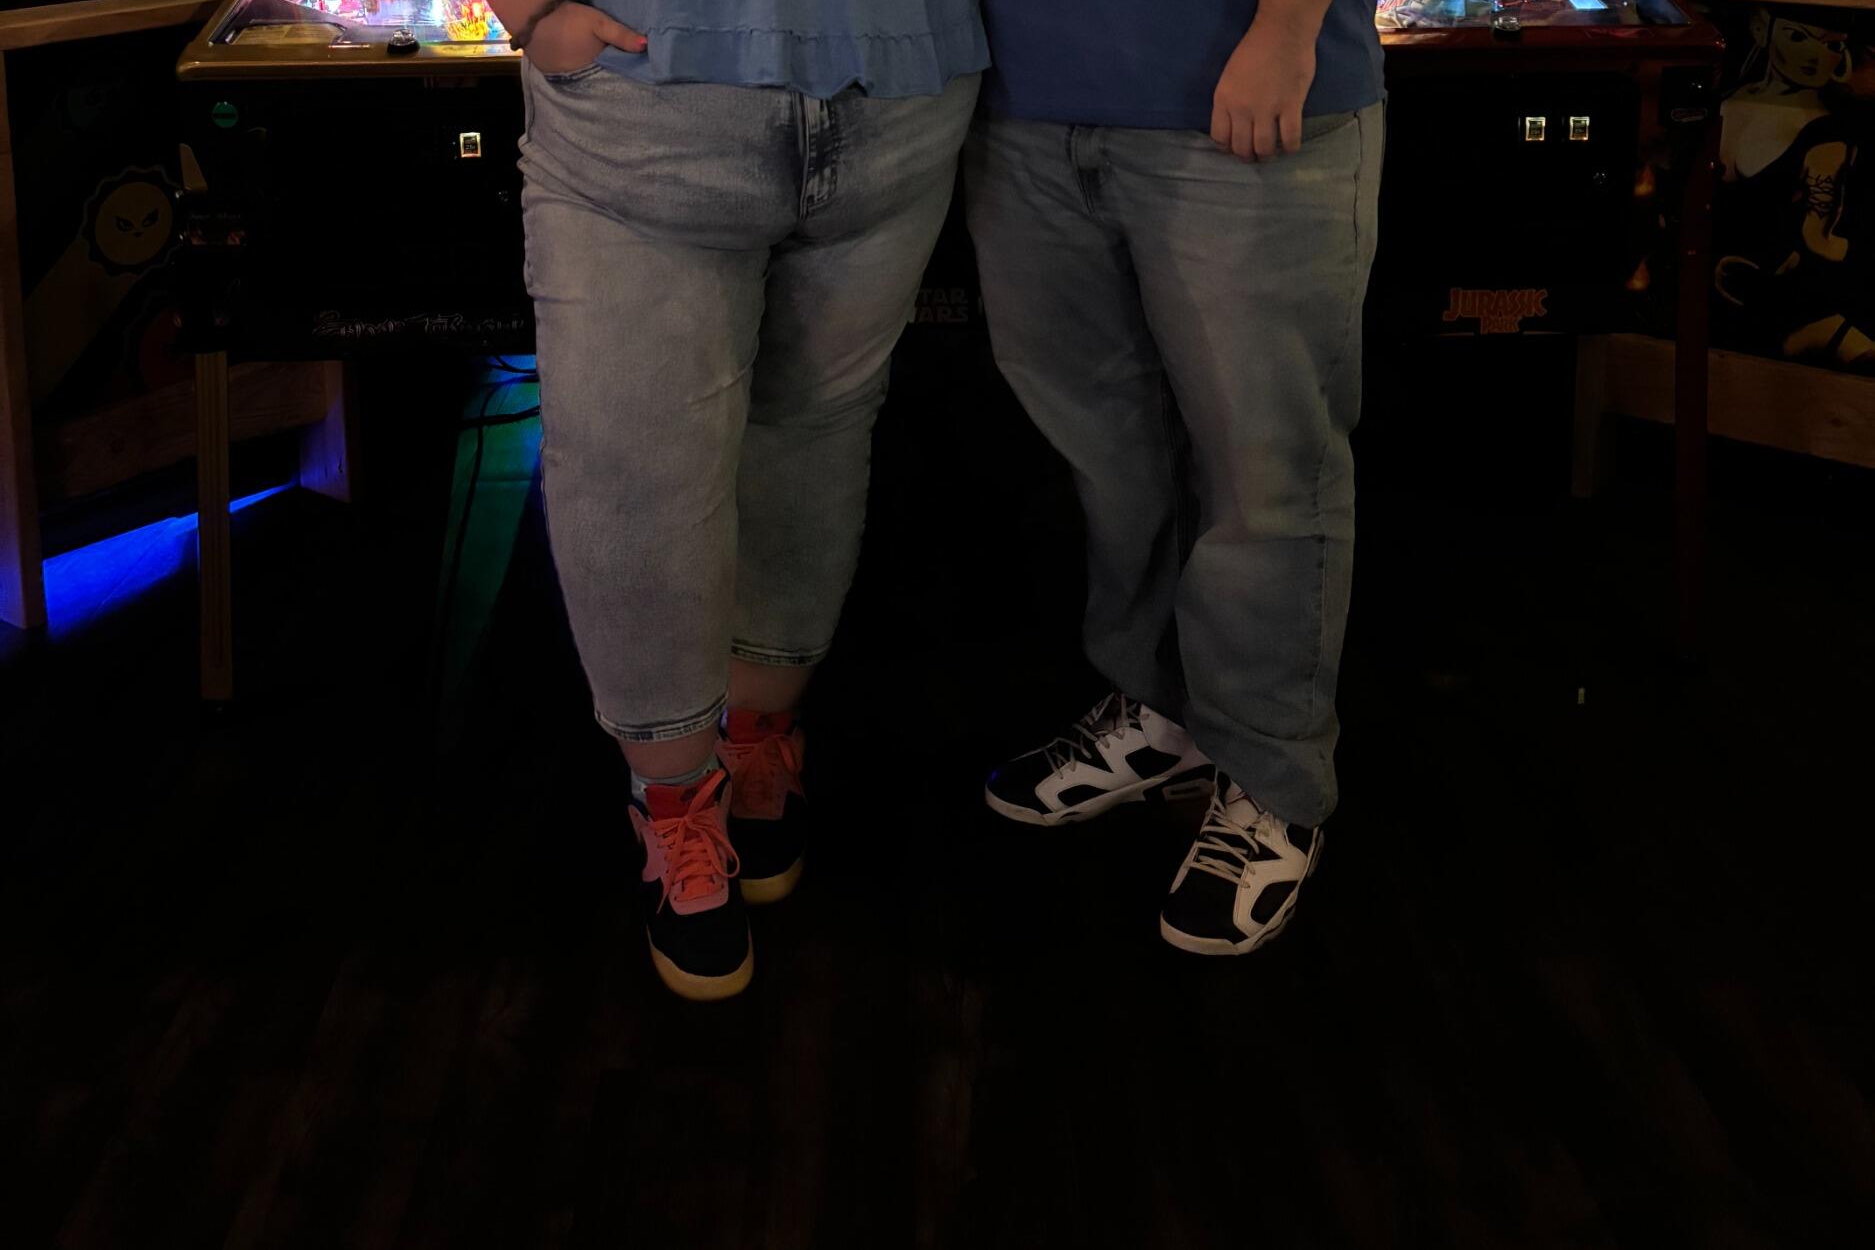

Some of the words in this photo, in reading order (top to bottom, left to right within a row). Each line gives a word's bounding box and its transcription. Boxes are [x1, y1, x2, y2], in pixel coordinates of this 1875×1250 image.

[919, 287, 968, 305] TAR
[1443, 288, 1548, 322] JURASSIC
[918, 306, 968, 324] ARS
